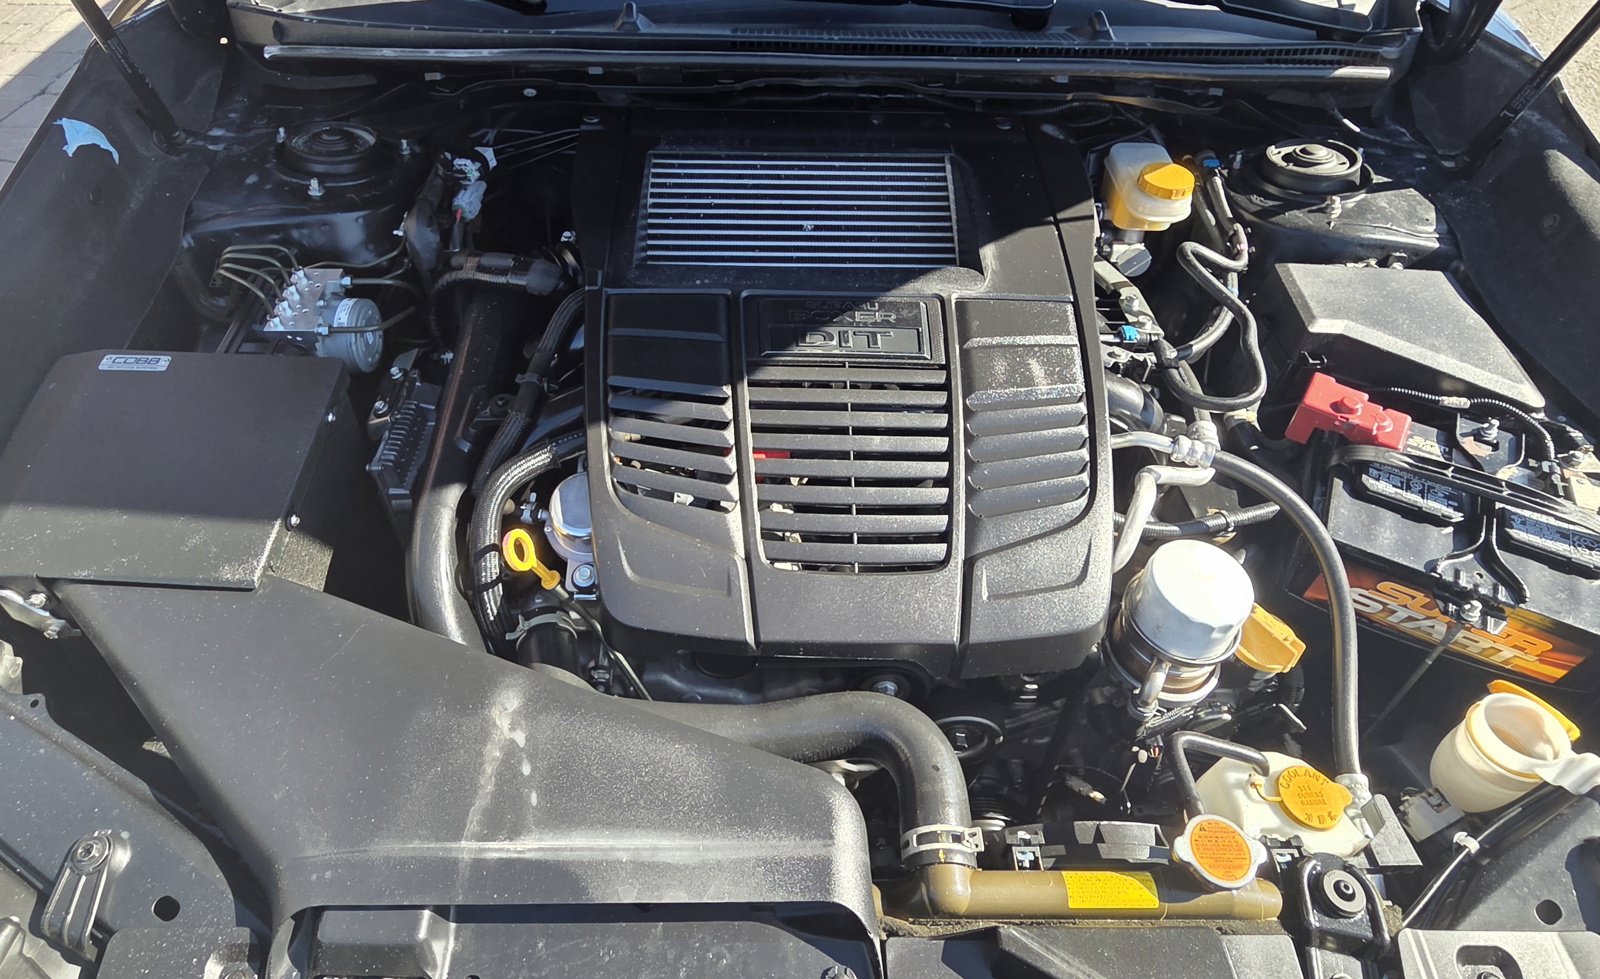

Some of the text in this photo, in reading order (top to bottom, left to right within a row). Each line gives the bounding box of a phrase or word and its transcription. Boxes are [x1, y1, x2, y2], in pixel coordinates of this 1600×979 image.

[789, 310, 897, 323] BOXER
[797, 330, 893, 349] DIT
[112, 356, 161, 364] COBB
[1350, 587, 1540, 669] START
[1376, 581, 1553, 657] SUER
[1280, 768, 1329, 790] COOLANT
